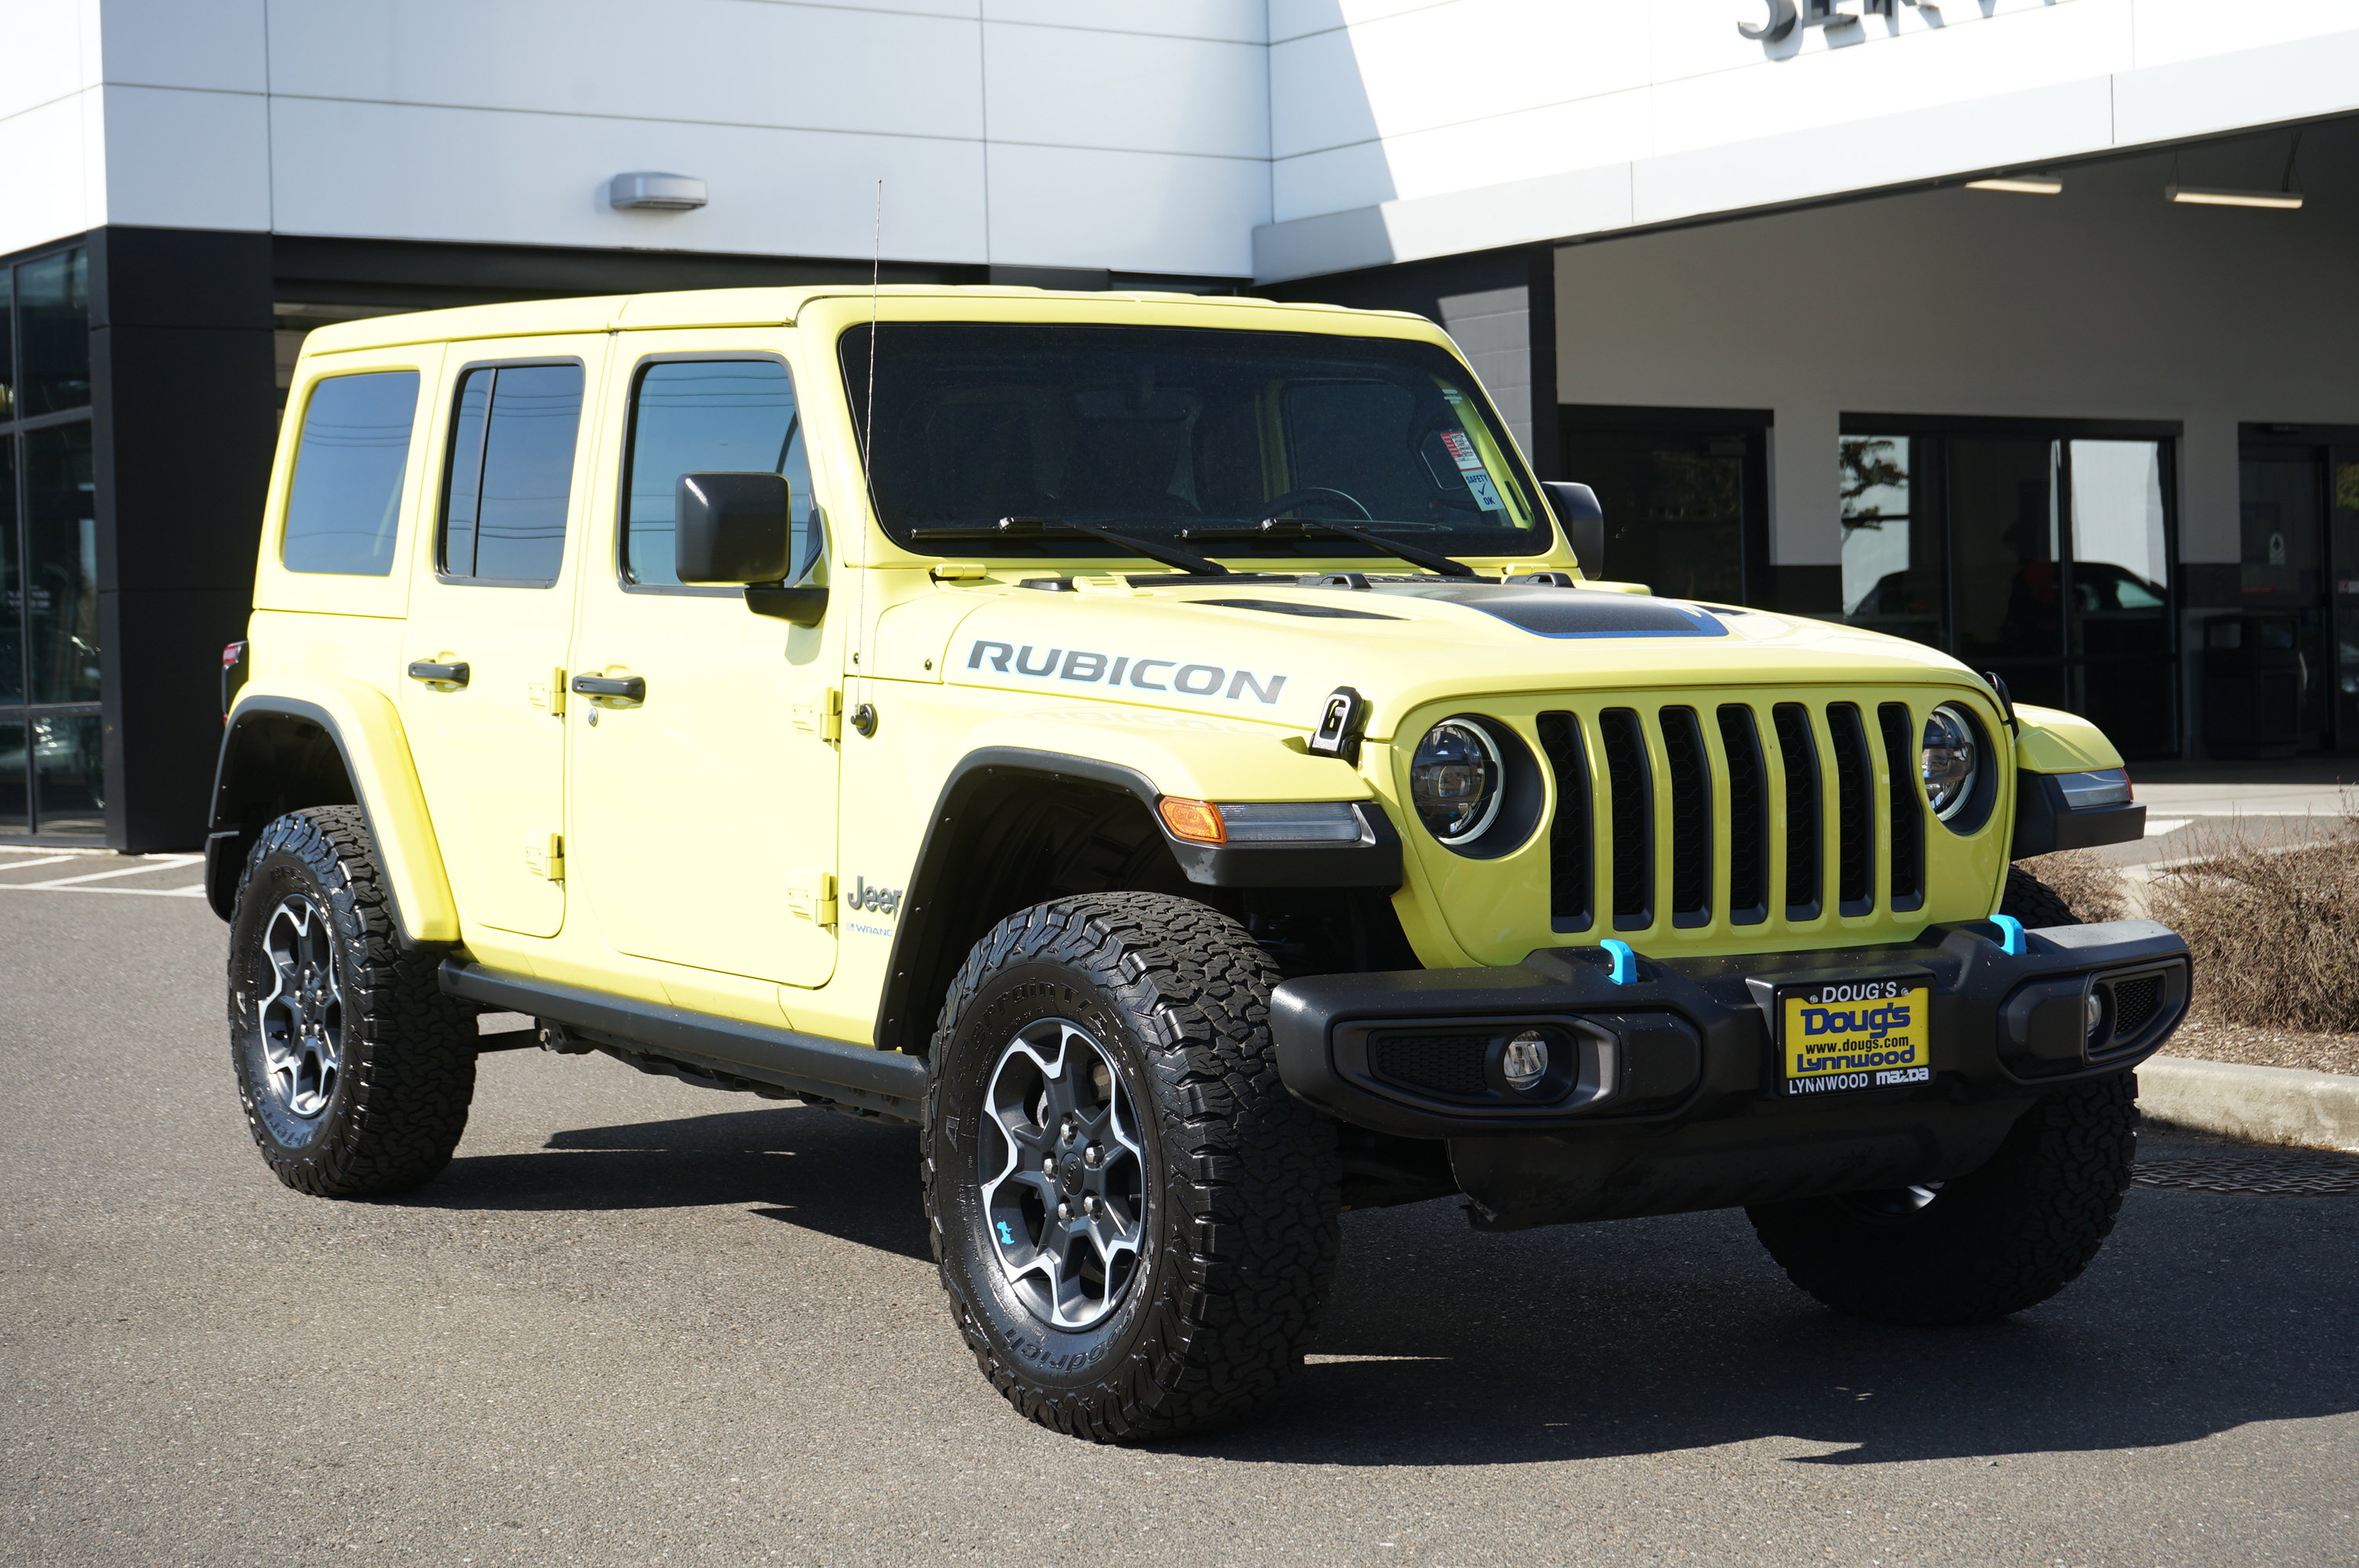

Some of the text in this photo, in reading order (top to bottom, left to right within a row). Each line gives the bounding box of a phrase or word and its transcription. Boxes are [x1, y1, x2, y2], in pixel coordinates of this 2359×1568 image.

[1465, 474, 1488, 485] SAFETY
[1483, 496, 1496, 506] OK
[966, 640, 1288, 705] RUBICON
[1822, 982, 1897, 1004] DOUG'S
[1801, 1002, 1911, 1039] Doug's
[1805, 1036, 1910, 1054] www.dougs.com
[1797, 1044, 1916, 1073] Lynnwood
[1789, 1073, 1869, 1094] LYNNWOOD
